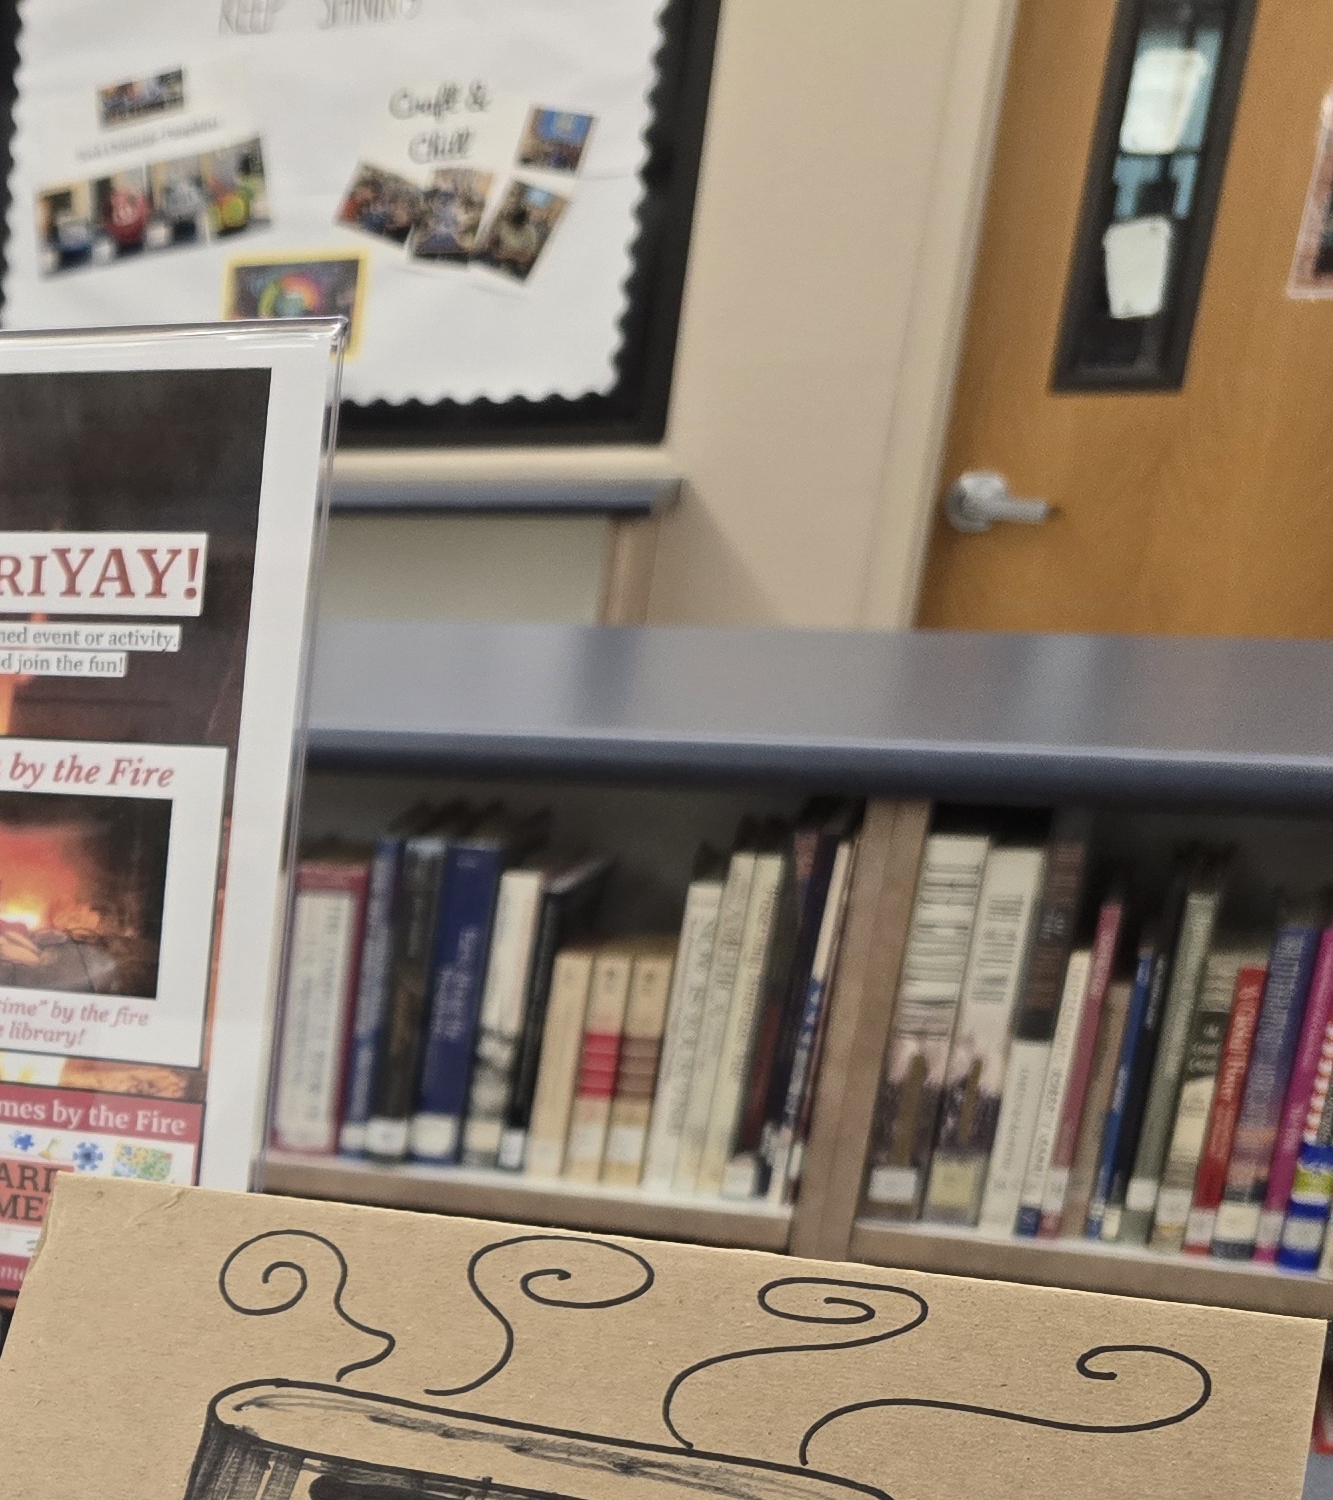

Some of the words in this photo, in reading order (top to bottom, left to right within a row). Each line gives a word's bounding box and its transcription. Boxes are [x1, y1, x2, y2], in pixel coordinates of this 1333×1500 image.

[32, 629, 81, 646] event
[83, 631, 105, 647] or
[107, 628, 180, 649] activity.
[17, 653, 52, 672] join
[55, 653, 85, 673] the
[88, 654, 124, 674] fun!
[8, 753, 47, 786] by
[52, 754, 102, 785] the
[106, 757, 175, 789] Fire
[49, 999, 76, 1025] by
[79, 1002, 111, 1024] the
[108, 1004, 150, 1028] fire
[7, 1019, 88, 1048] library!
[51, 1098, 85, 1128] by
[88, 1103, 130, 1130] the
[135, 1109, 188, 1137] Fire
